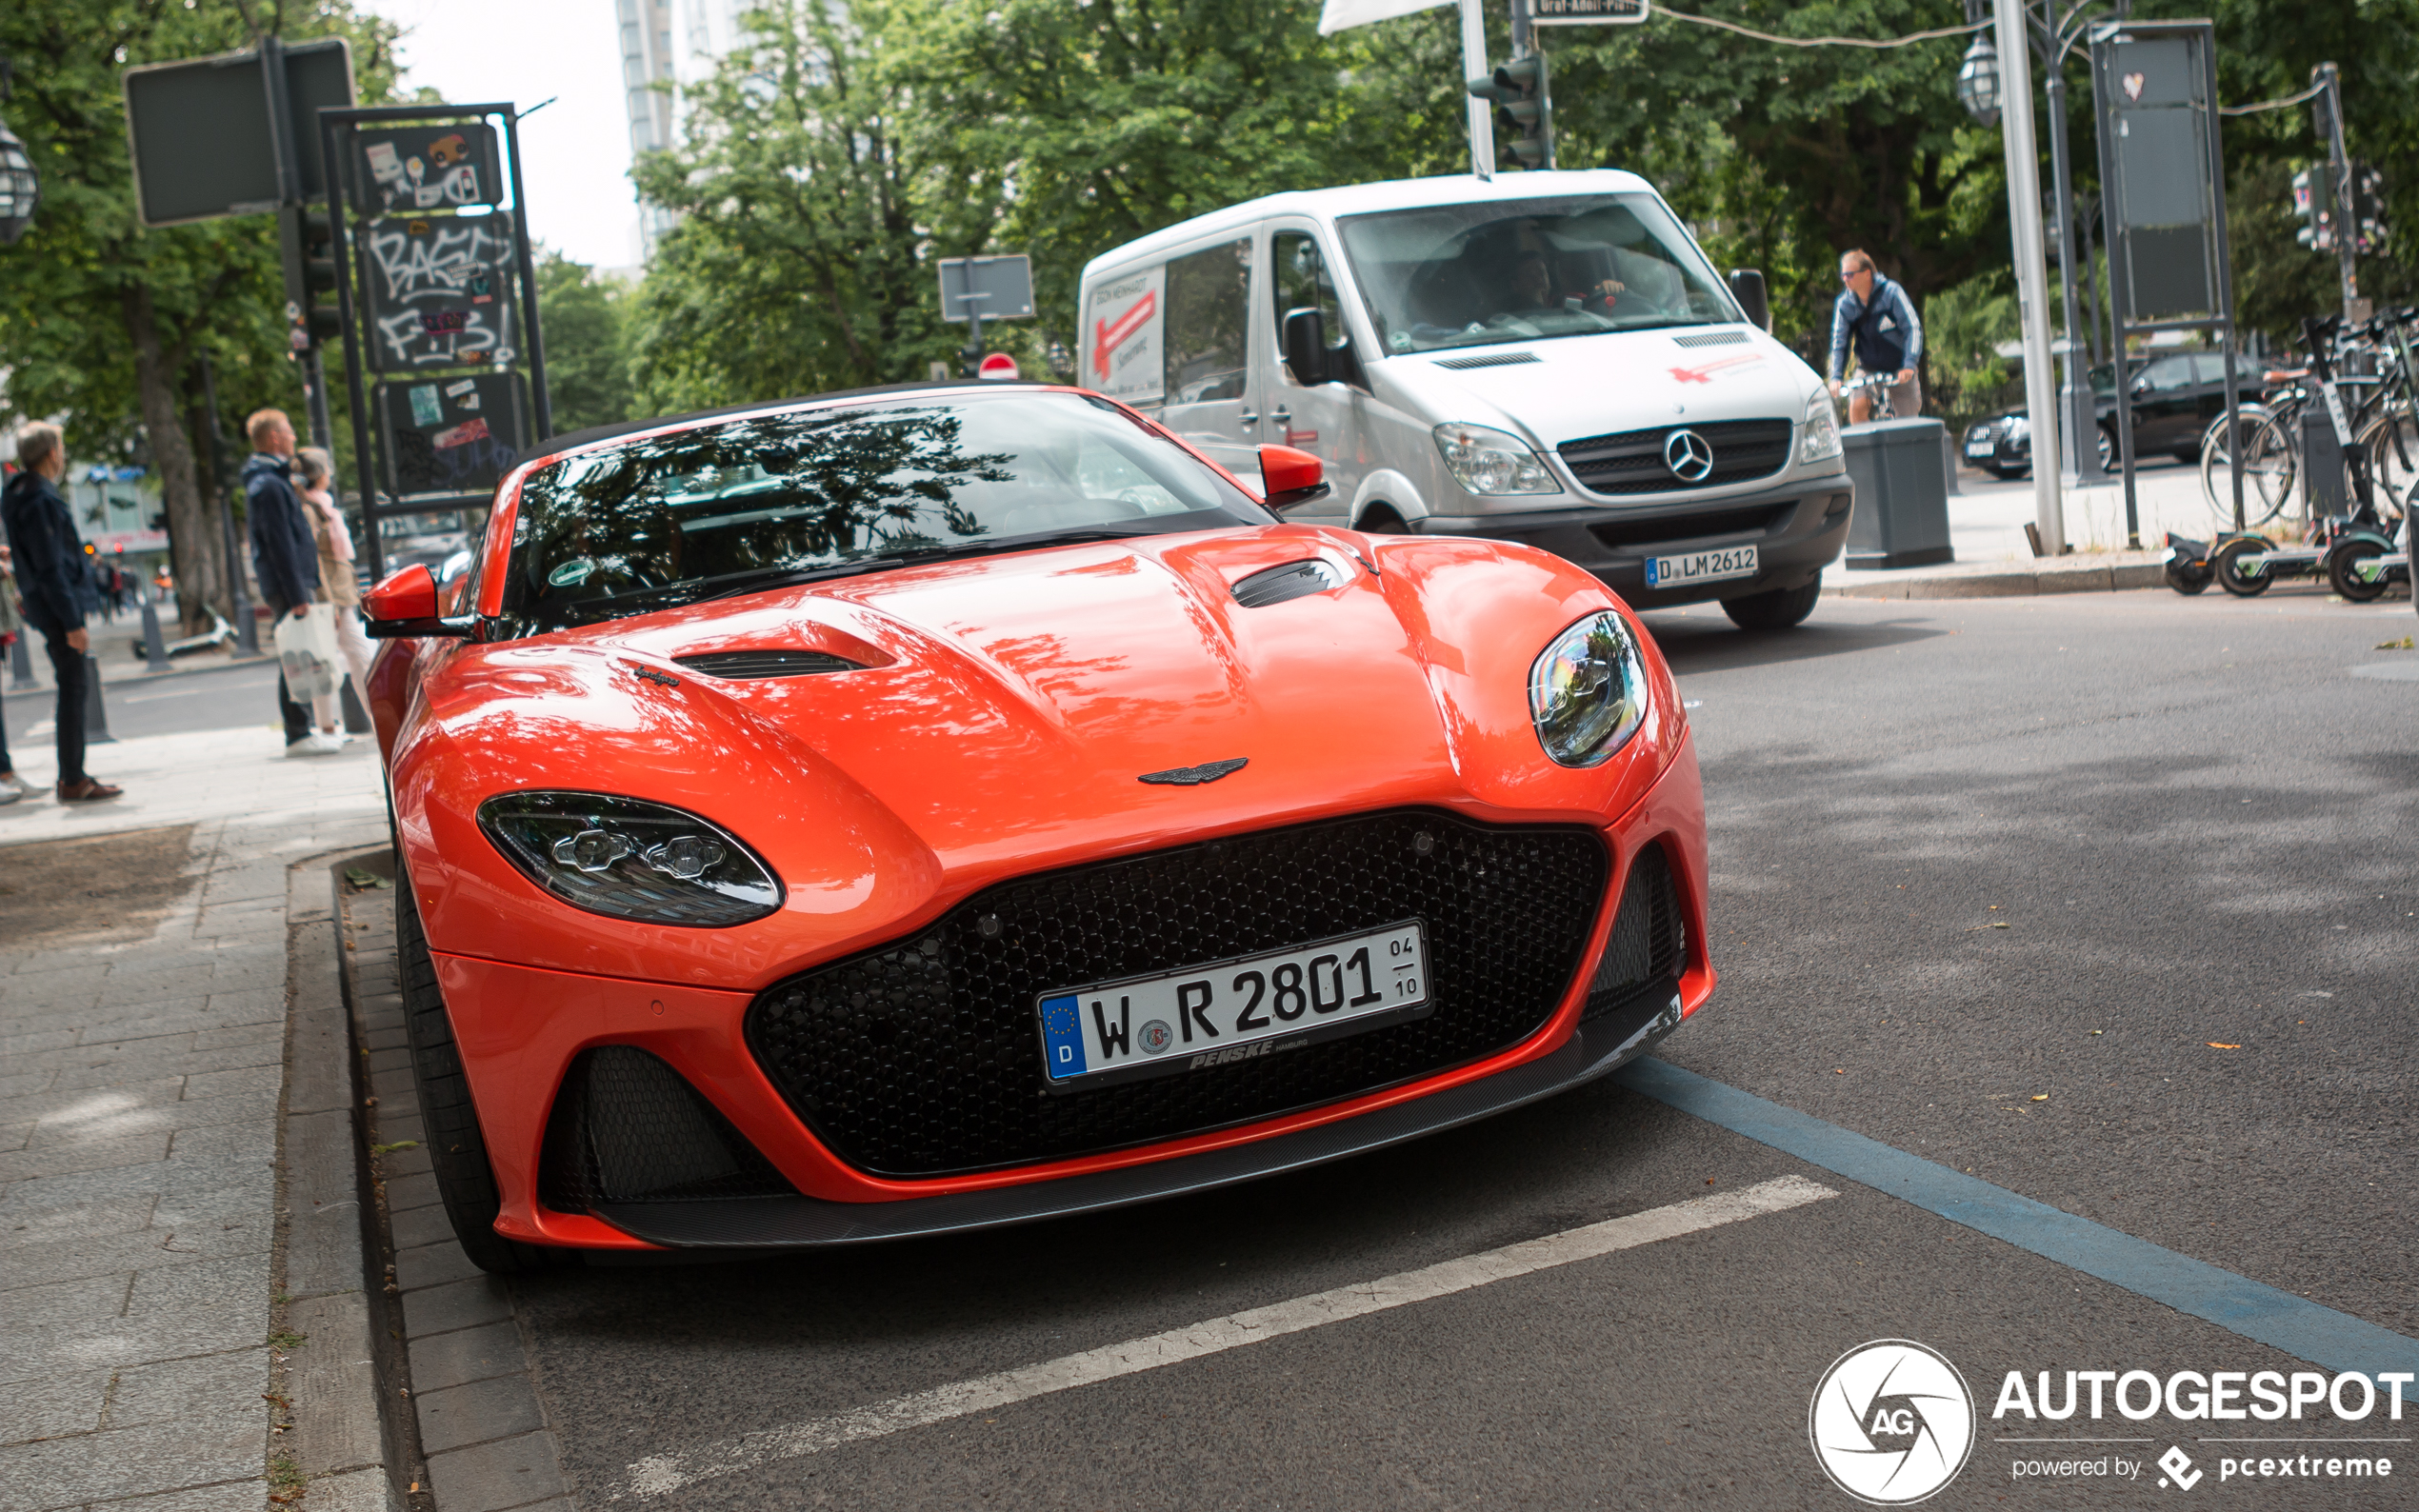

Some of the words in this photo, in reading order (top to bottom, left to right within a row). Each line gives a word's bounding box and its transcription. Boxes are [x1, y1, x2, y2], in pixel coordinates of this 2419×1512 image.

[1659, 560, 1671, 580] D
[1389, 935, 1413, 957] 04
[1394, 977, 1417, 997] 10
[1091, 995, 1130, 1059] W
[1176, 979, 1220, 1043] R
[1232, 946, 1383, 1032] 2801
[1058, 1044, 1073, 1064] D
[1189, 1040, 1274, 1070] PENSKE
[1275, 1039, 1309, 1052] HAMBURG
